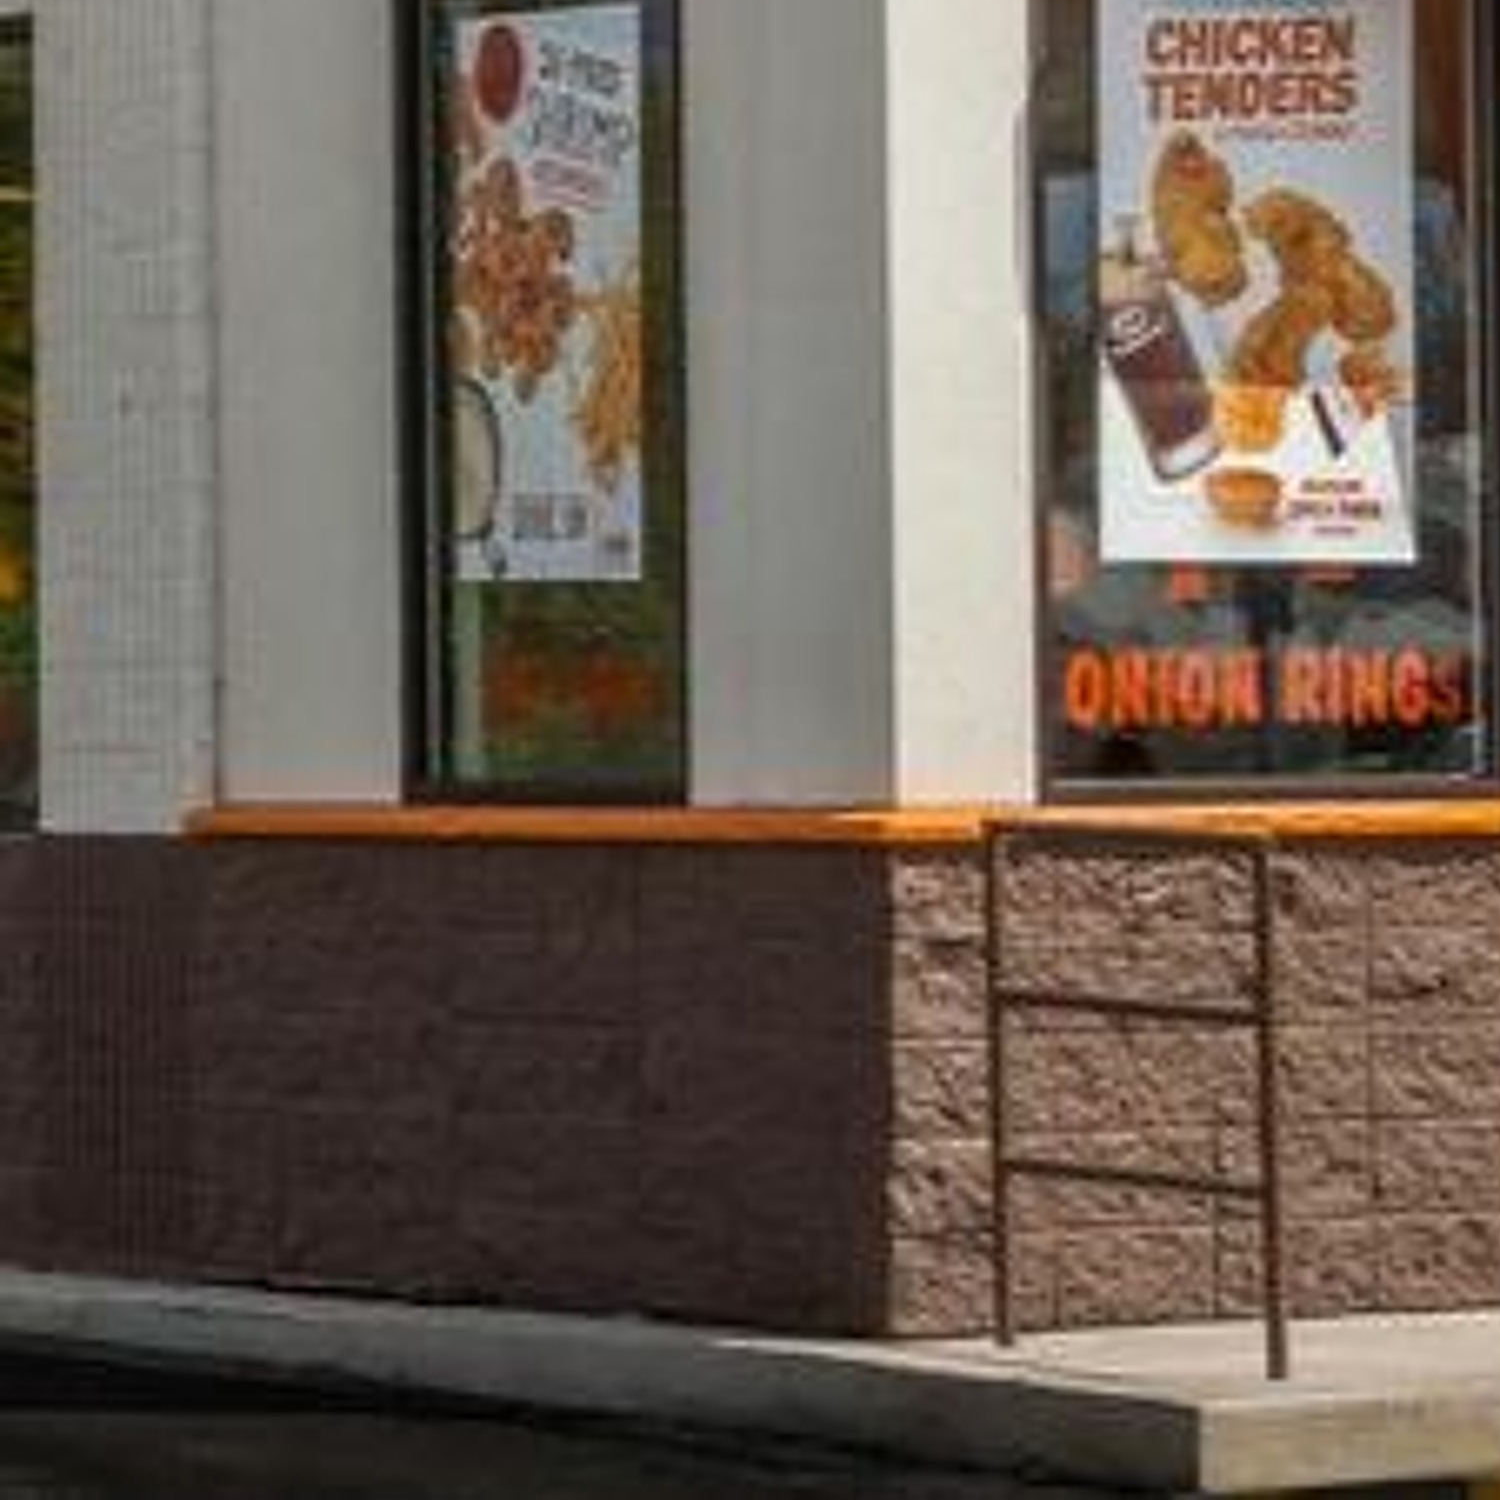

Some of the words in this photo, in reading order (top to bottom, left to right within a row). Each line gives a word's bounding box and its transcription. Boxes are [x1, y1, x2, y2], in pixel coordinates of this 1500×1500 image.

[1145, 14, 1355, 67] CHICKEN
[1142, 72, 1360, 126] TENDERS
[1064, 642, 1264, 731] ONION
[1279, 641, 1468, 730] RINGS
